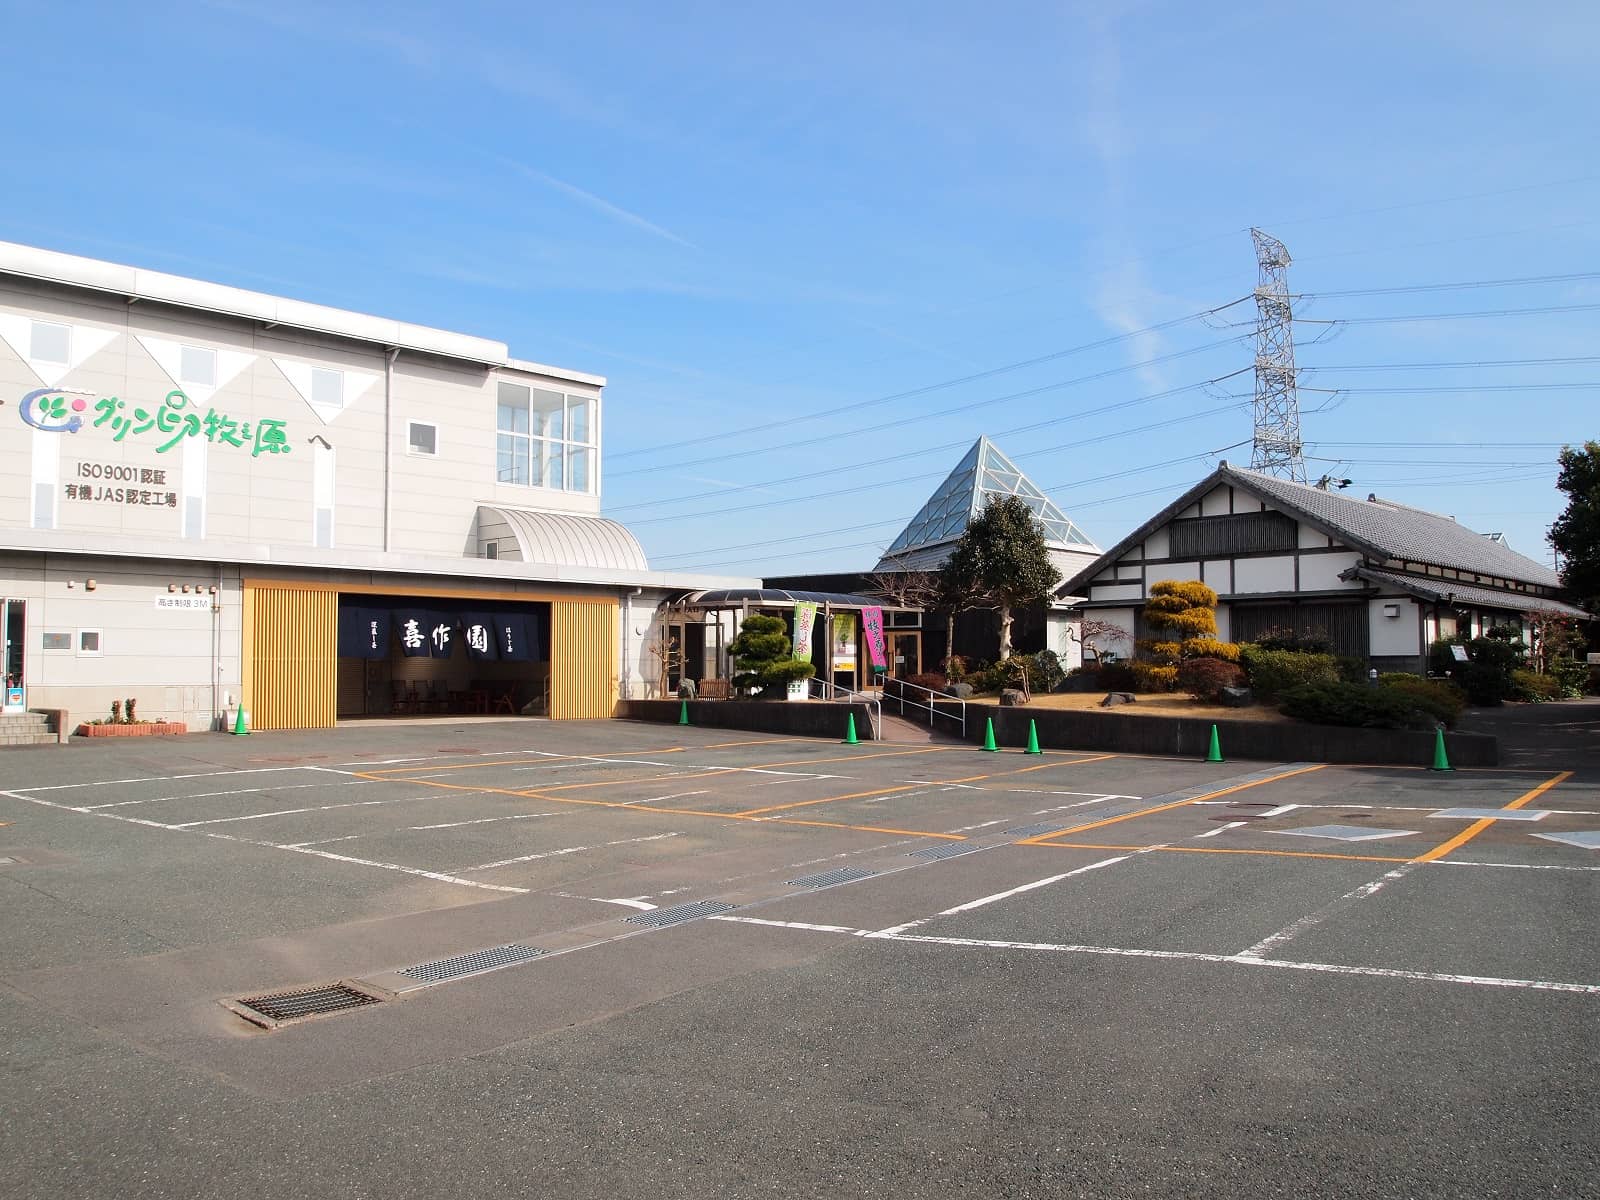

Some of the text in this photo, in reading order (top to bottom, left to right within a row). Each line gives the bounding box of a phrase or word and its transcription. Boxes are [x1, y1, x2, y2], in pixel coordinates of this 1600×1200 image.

[77, 462, 166, 486] ISO9001認証
[65, 483, 177, 508] 有機JAS認定工場
